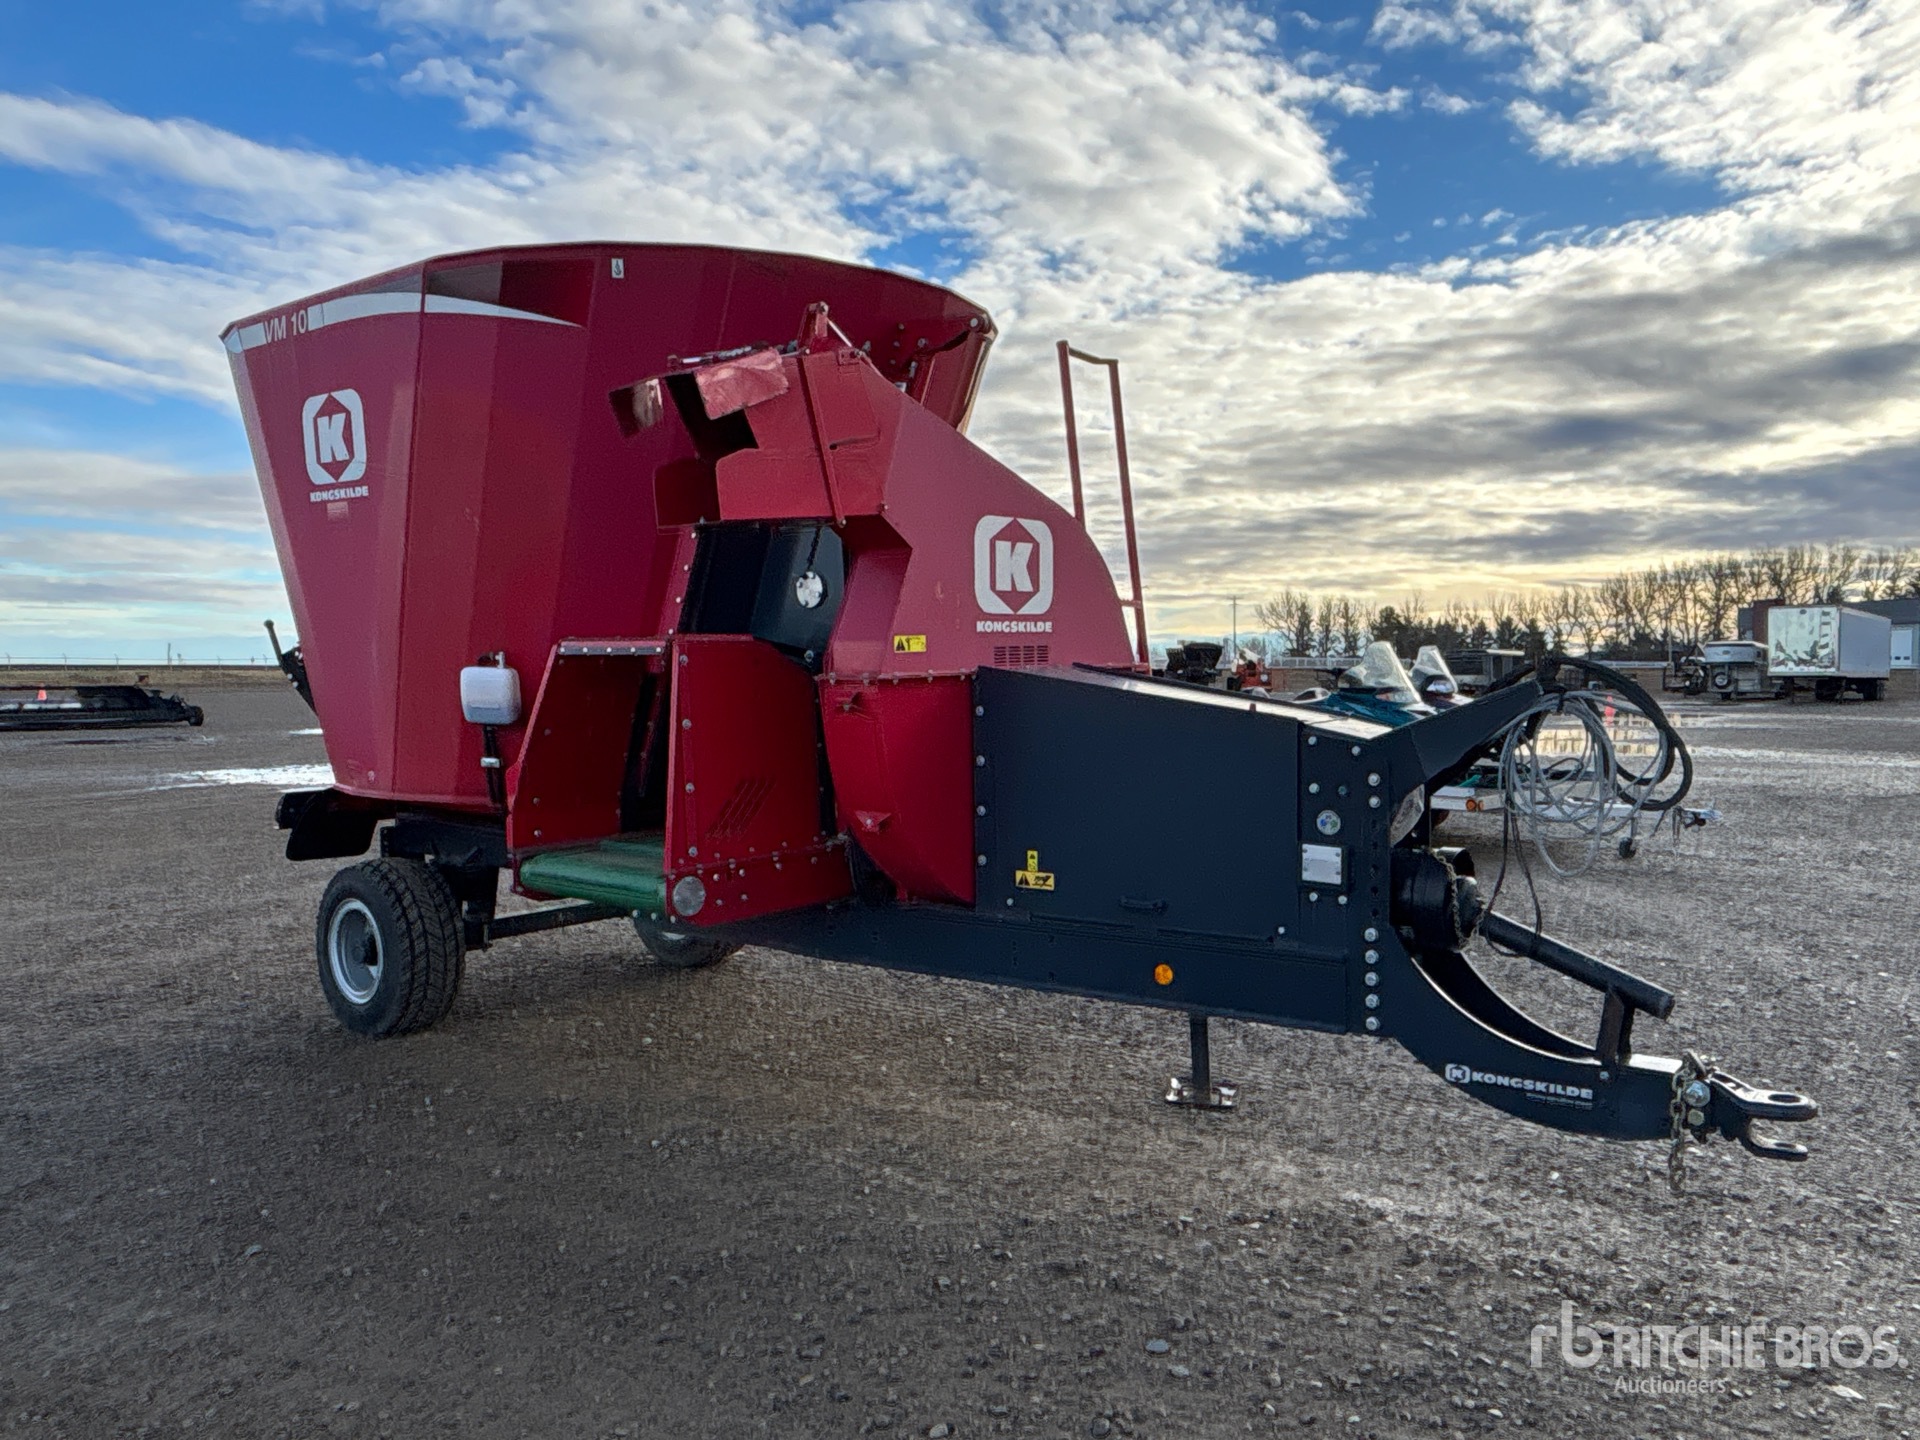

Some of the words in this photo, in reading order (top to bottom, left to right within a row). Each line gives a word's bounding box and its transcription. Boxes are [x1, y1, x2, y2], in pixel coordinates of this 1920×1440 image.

[264, 315, 287, 344] VM
[290, 309, 307, 336] 10
[309, 485, 370, 503] KONGSKILDE
[976, 620, 1053, 633] KONGSKILDE
[1472, 1071, 1594, 1100] KONGSKILDE
